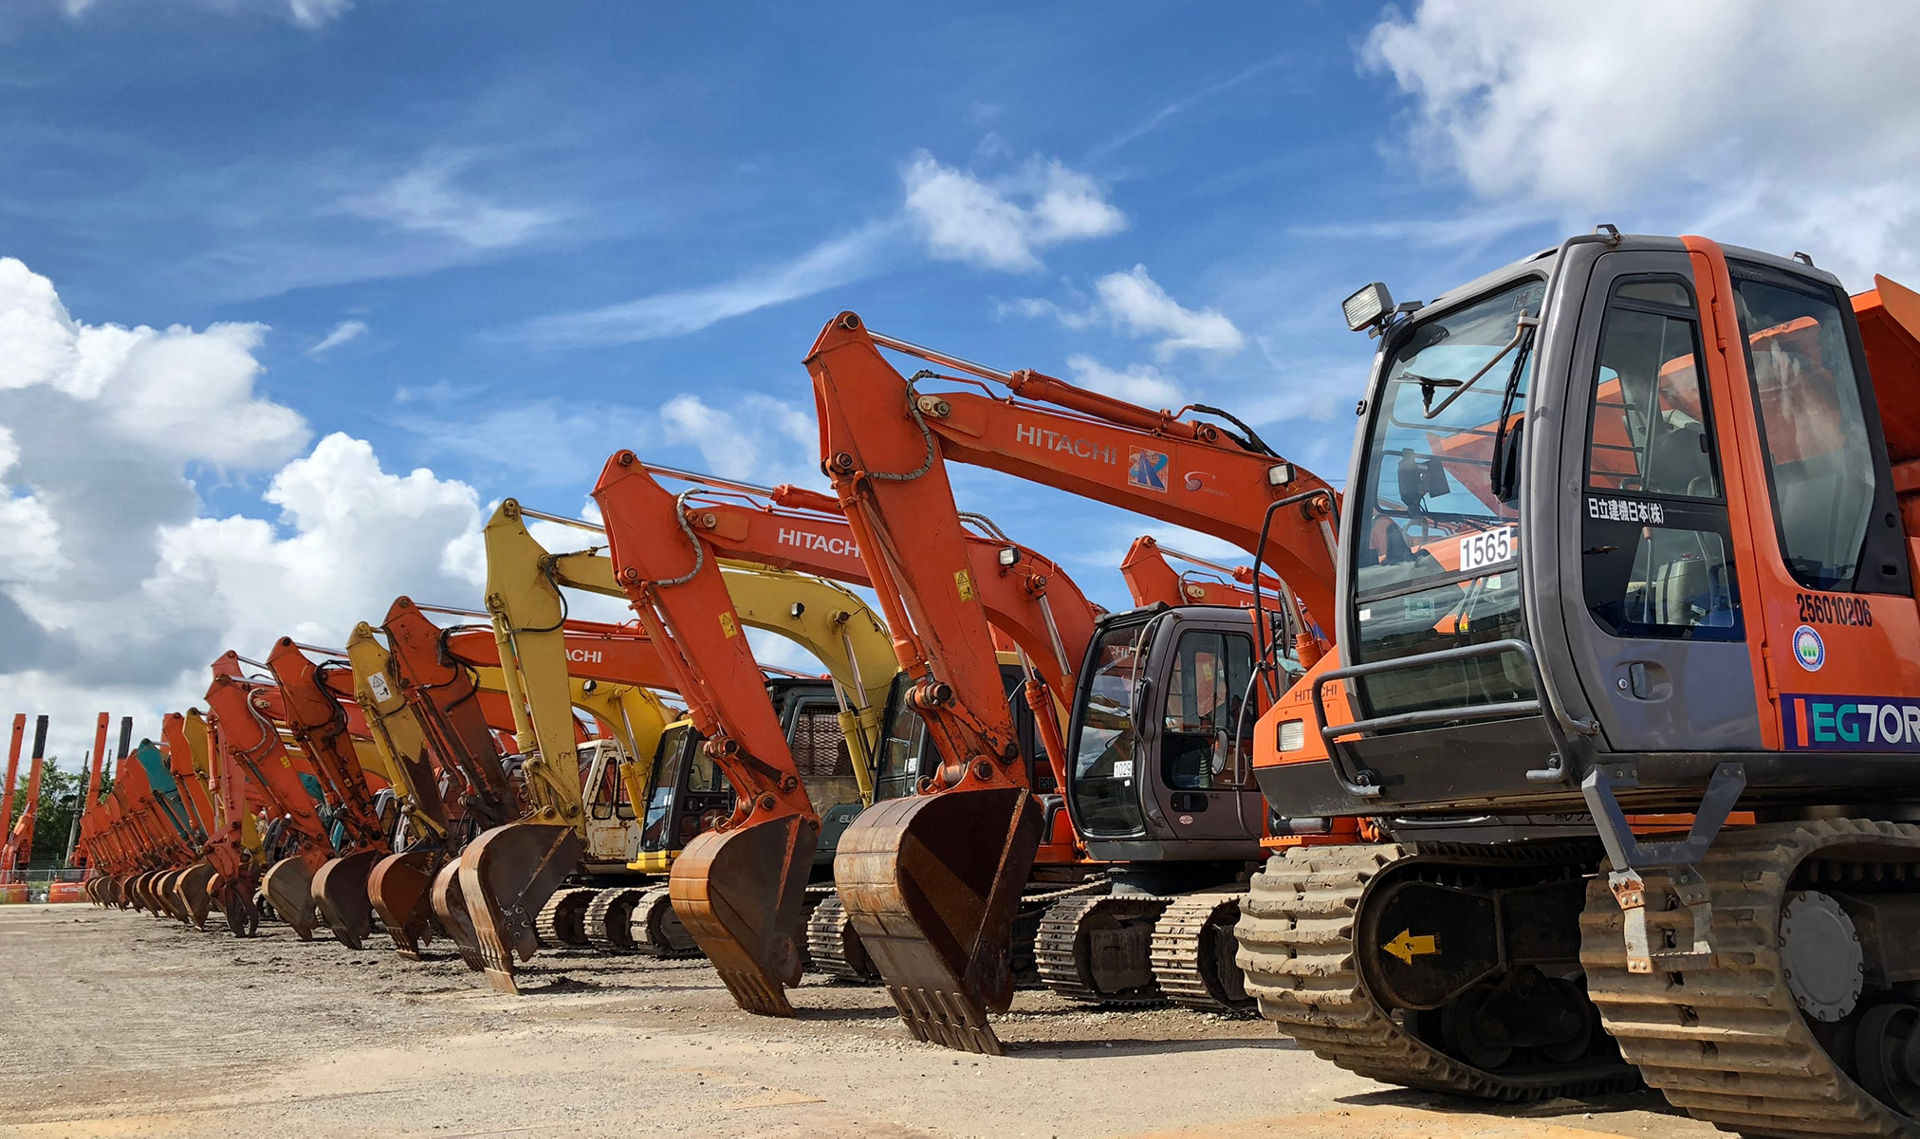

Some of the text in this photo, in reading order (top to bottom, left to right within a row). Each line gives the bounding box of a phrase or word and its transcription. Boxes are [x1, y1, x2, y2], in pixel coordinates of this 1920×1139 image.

[1016, 423, 1117, 465] HITACHI
[778, 528, 860, 558] HITACH
[1463, 530, 1508, 567] 1565
[1796, 593, 1872, 627] 256010206
[1295, 684, 1337, 702] HITCHI
[1812, 704, 1920, 743] EG70R
